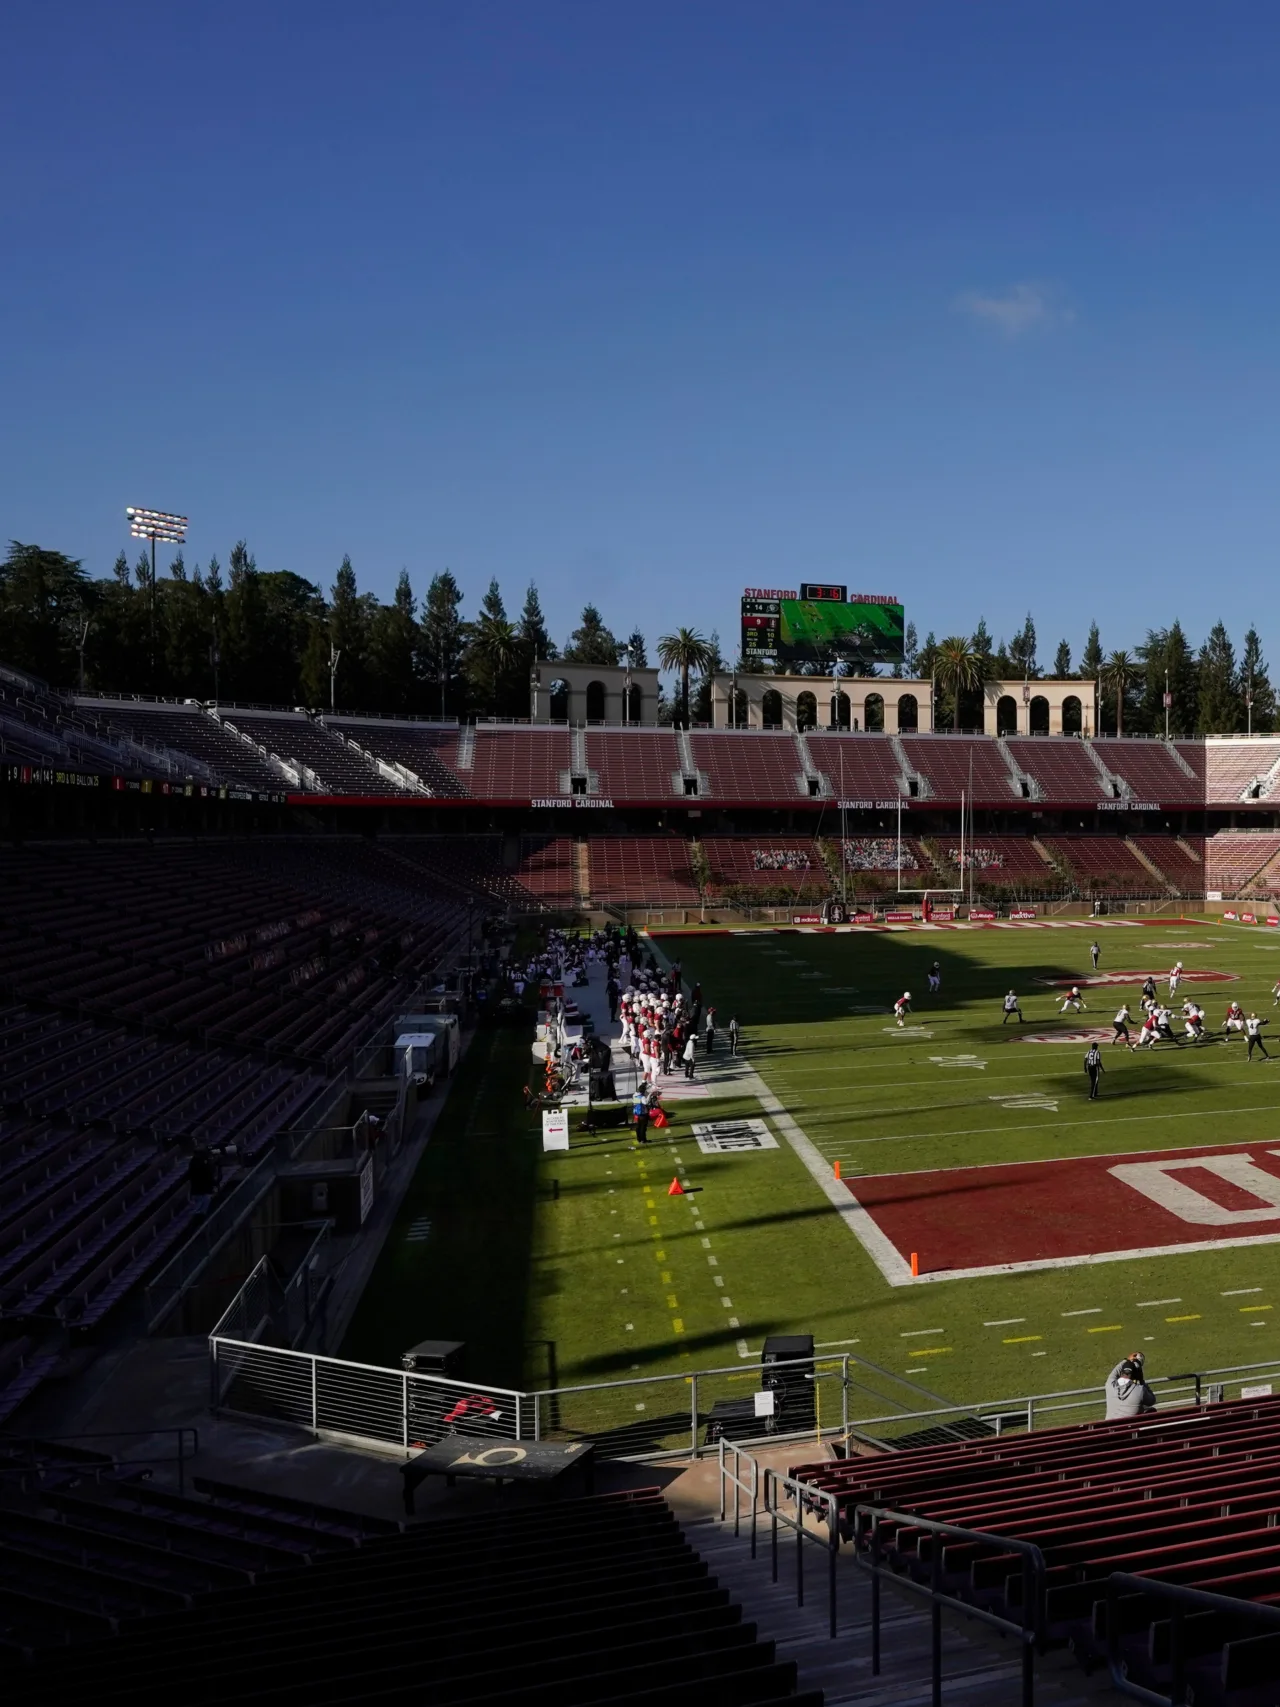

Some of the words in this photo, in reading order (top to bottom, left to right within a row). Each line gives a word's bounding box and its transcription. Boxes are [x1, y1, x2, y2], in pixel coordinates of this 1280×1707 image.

[744, 588, 797, 600] STANFORD
[816, 588, 839, 599] 3:16
[850, 594, 899, 605] CARDINAL
[745, 648, 777, 656] STANFORD
[531, 800, 572, 808] STANFORD
[575, 800, 615, 808] CARDINAL
[837, 801, 873, 809] STANFORD
[876, 801, 909, 809] CARDINAL
[1011, 911, 1035, 919] nextiva
